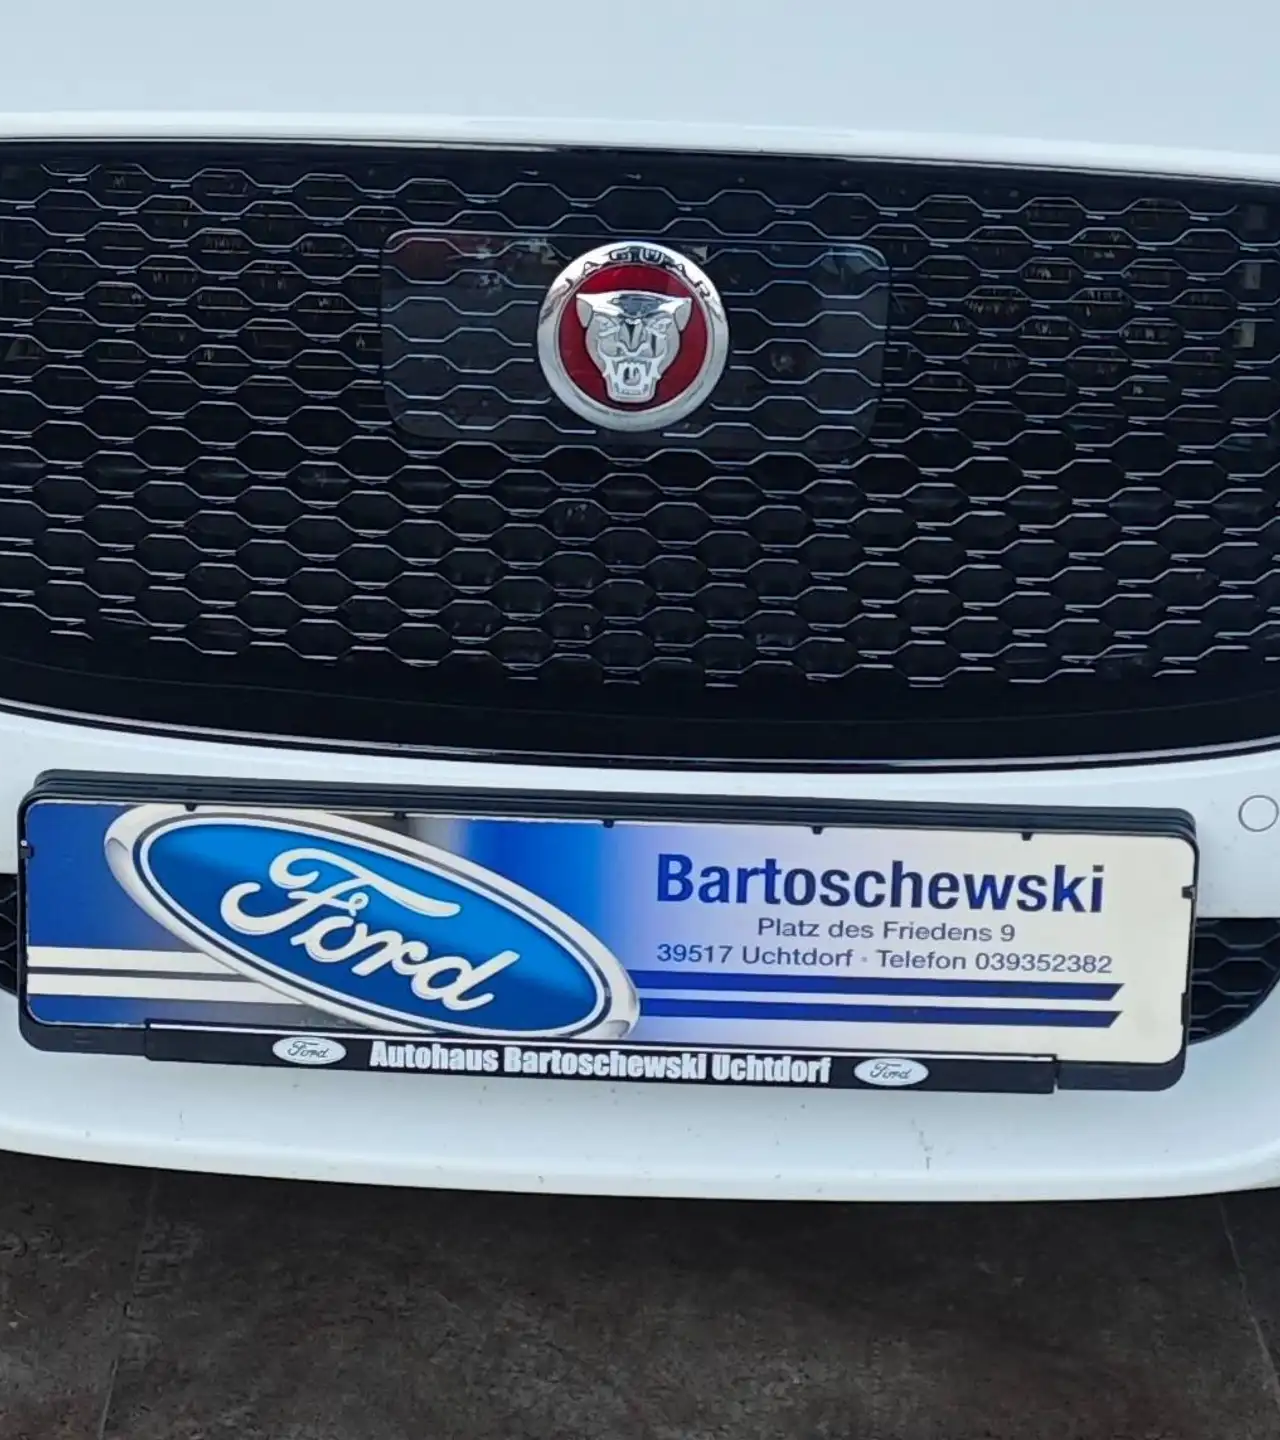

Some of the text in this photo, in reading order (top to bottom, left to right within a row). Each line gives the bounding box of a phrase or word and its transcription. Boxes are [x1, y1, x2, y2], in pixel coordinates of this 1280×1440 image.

[558, 248, 711, 298] JAGUAR
[656, 852, 1105, 914] Bartoschewski
[220, 846, 520, 1011] Ford
[757, 918, 1016, 943] Platz des Friedens 9
[656, 943, 733, 964] 39517
[742, 946, 854, 968] Uchtdorf
[875, 949, 966, 970] Telefon
[975, 951, 1113, 974] 039352382
[286, 1039, 329, 1059] Ford
[369, 1040, 832, 1084] Autohaus Bartoschewski Uchtdorf
[869, 1061, 913, 1080] Ford
